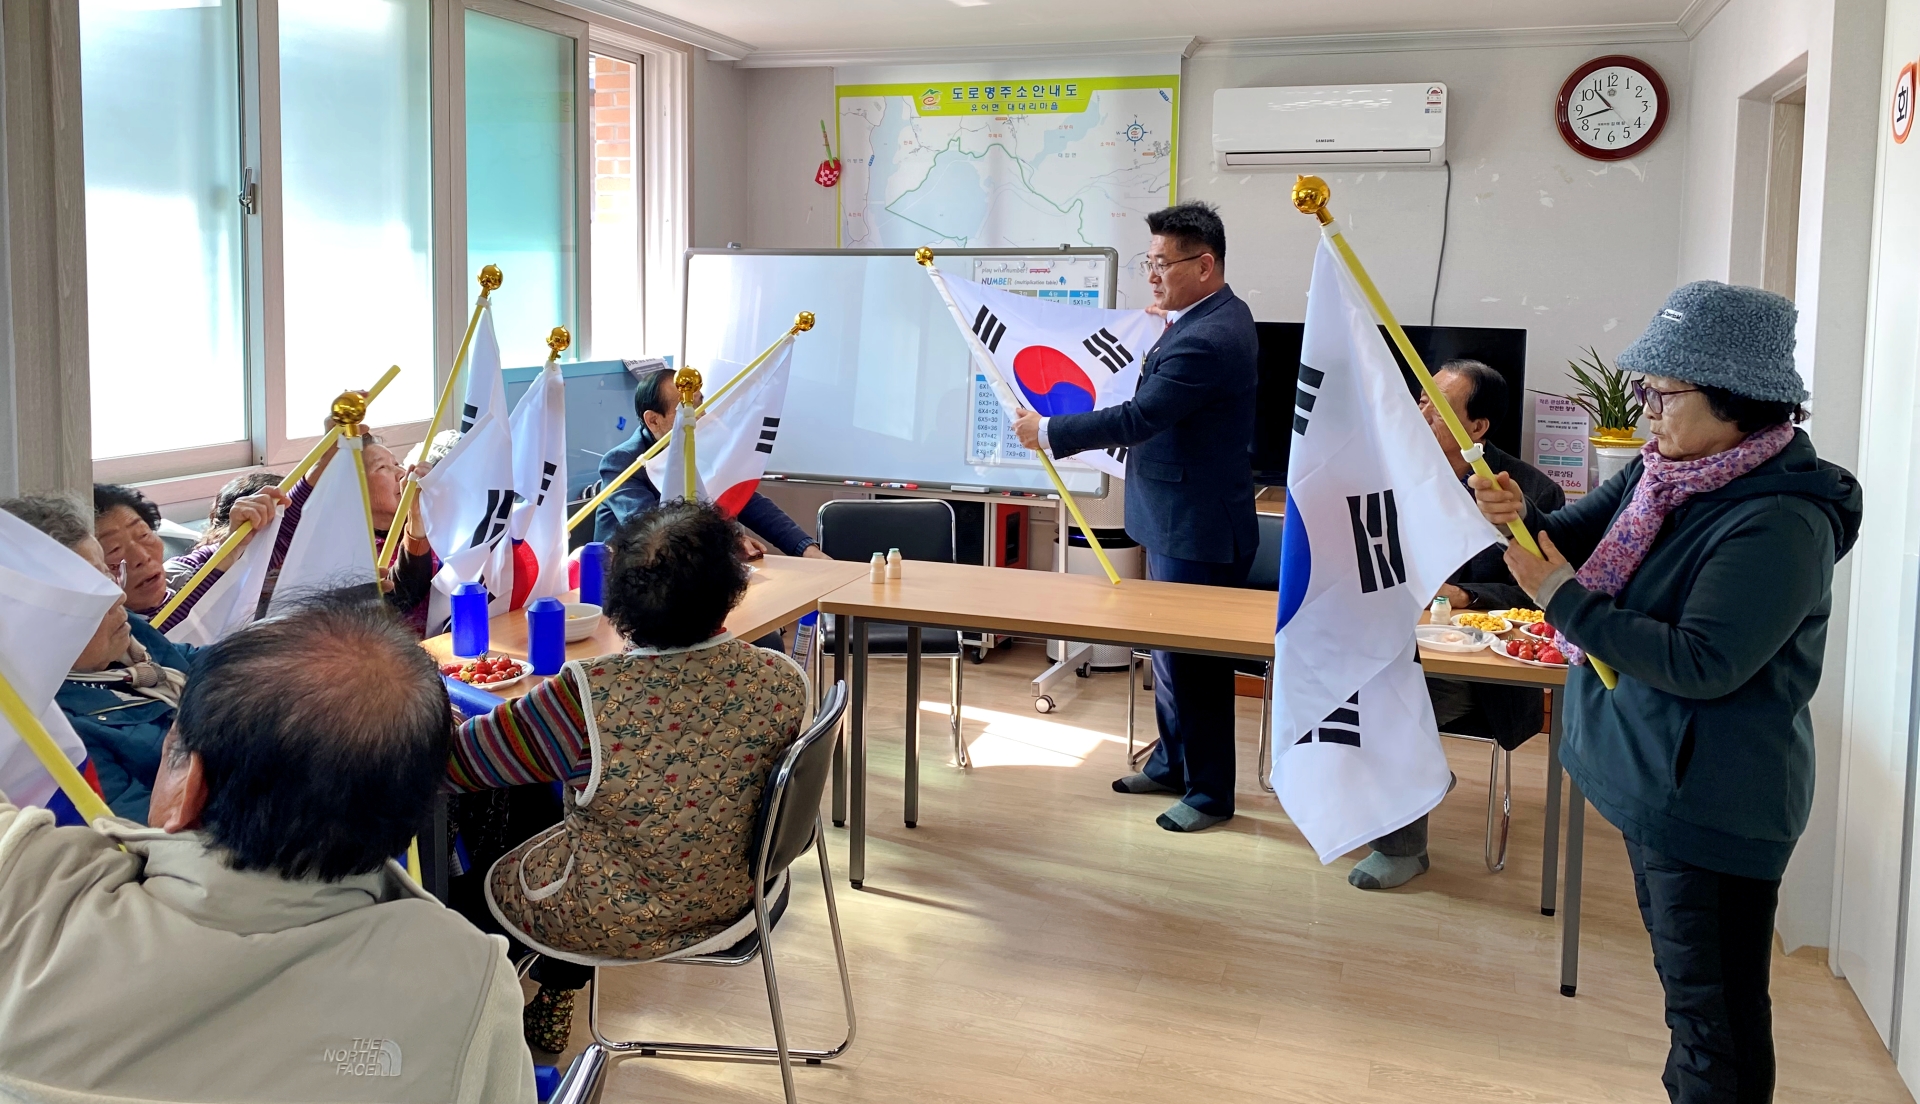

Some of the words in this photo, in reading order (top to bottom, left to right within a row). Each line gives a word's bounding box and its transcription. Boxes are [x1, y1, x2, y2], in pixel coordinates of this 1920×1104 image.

[1594, 79, 1602, 91] 11
[1607, 74, 1618, 87] 12
[1625, 76, 1630, 89] 1
[952, 84, 1078, 100] 도로명주소안내도
[1581, 89, 1595, 101] 10
[1635, 86, 1643, 98] 2
[970, 102, 999, 112] 유어면
[1575, 104, 1584, 116] 9
[1641, 100, 1648, 113] 3
[1581, 119, 1589, 131] 8
[1633, 116, 1641, 128] 4
[1593, 128, 1600, 140] 7
[1607, 130, 1615, 142] 6
[1623, 127, 1630, 139] 5
[981, 277, 1013, 286] NUMBER
[1547, 470, 1574, 478] 무료상담
[352, 1037, 381, 1050] THE
[323, 1048, 379, 1063] NORTH
[336, 1062, 376, 1076] FACE
